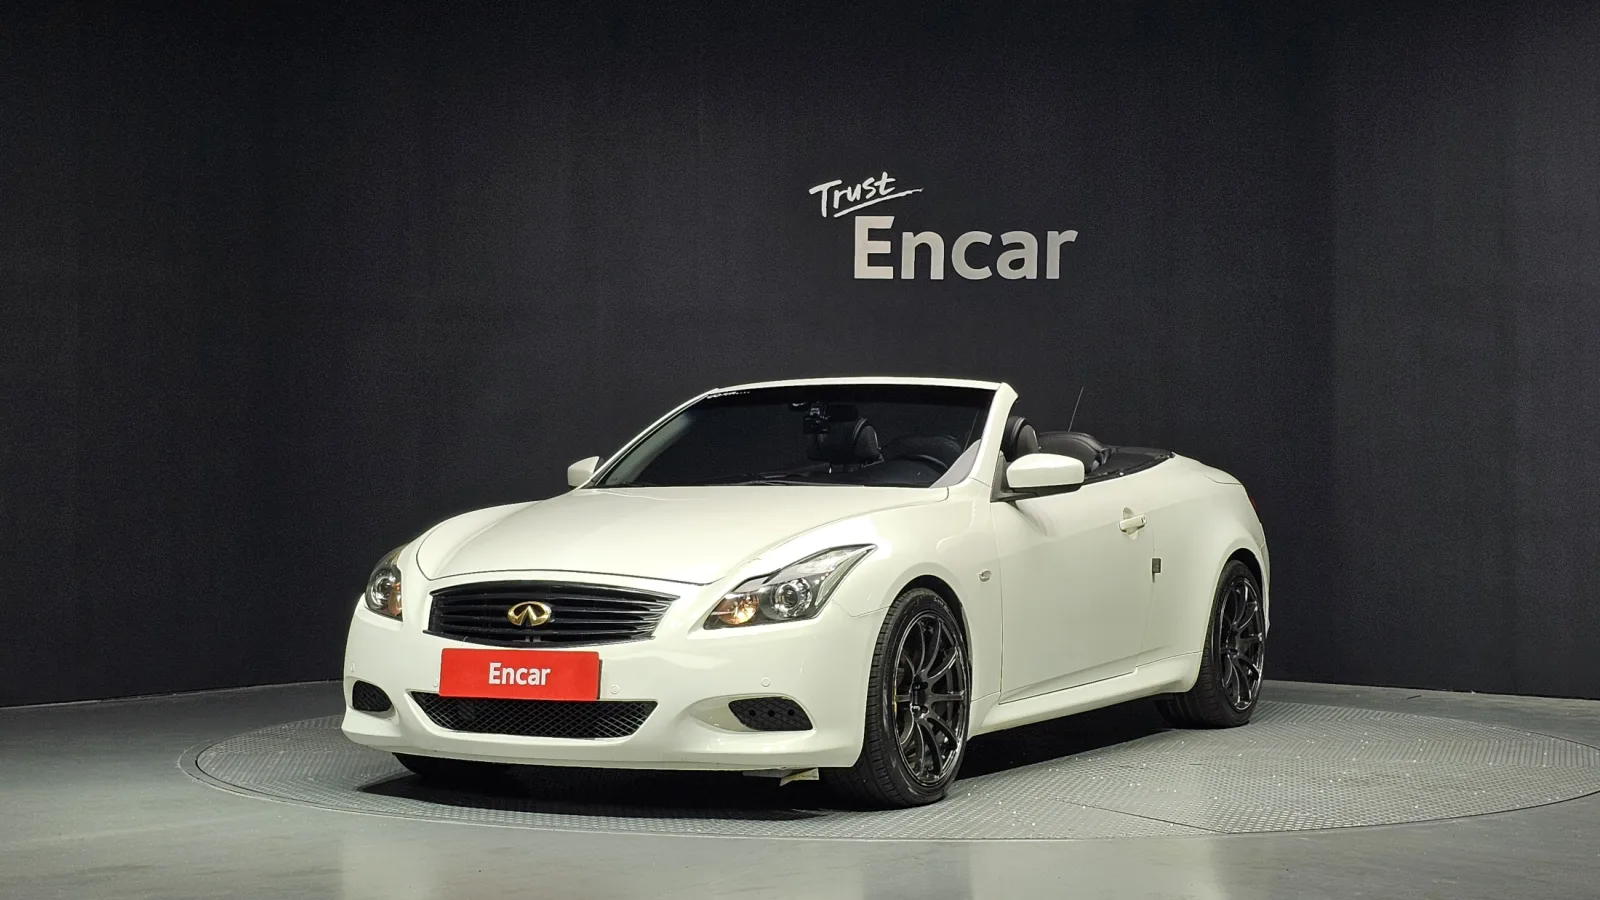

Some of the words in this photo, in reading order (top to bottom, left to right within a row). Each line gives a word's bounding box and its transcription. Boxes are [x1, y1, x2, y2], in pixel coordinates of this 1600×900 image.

[808, 171, 902, 218] Trust
[854, 215, 1079, 280] Encar
[488, 662, 552, 686] Encar
